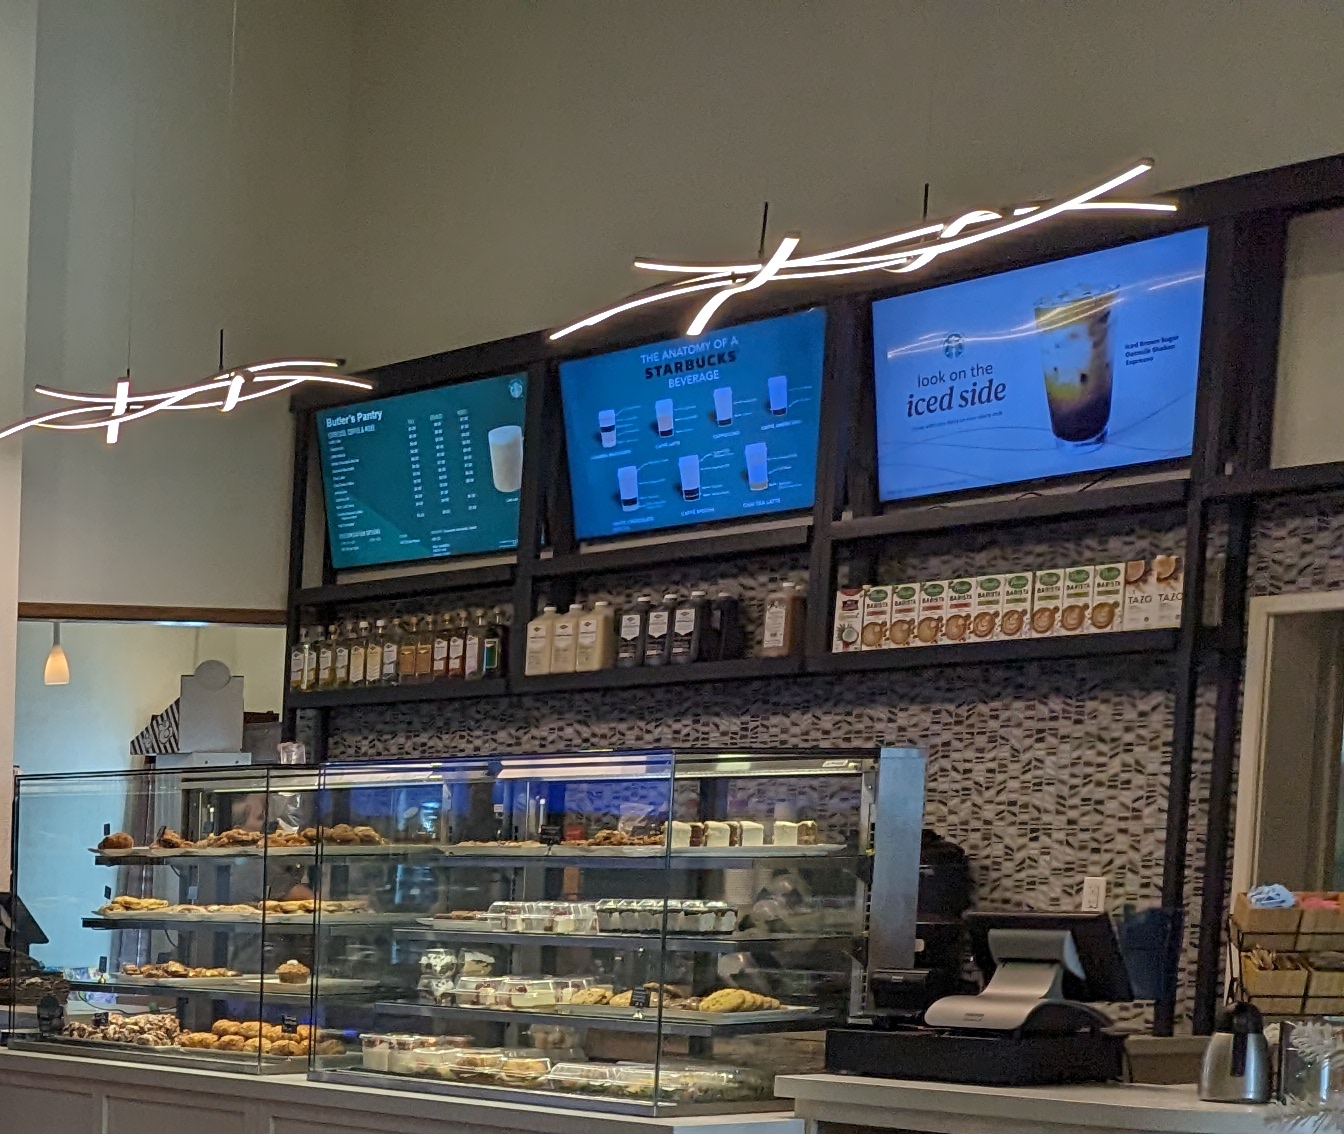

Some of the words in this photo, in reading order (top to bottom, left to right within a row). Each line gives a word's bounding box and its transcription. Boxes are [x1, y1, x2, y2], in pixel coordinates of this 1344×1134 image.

[640, 351, 660, 364] THE
[662, 341, 711, 360] ANATOMY
[713, 338, 728, 349] OF
[731, 335, 739, 345] A
[645, 350, 737, 379] STARBUCKS
[917, 370, 946, 388] look
[949, 369, 967, 382] on
[970, 363, 993, 378] the
[668, 369, 720, 389] BEVERAGE
[907, 385, 955, 418] iced
[958, 378, 1006, 408] side
[326, 414, 356, 428] Butler's
[357, 410, 383, 422] Pantry
[1128, 595, 1152, 604] TAZO
[1158, 592, 1183, 602] TAZO
